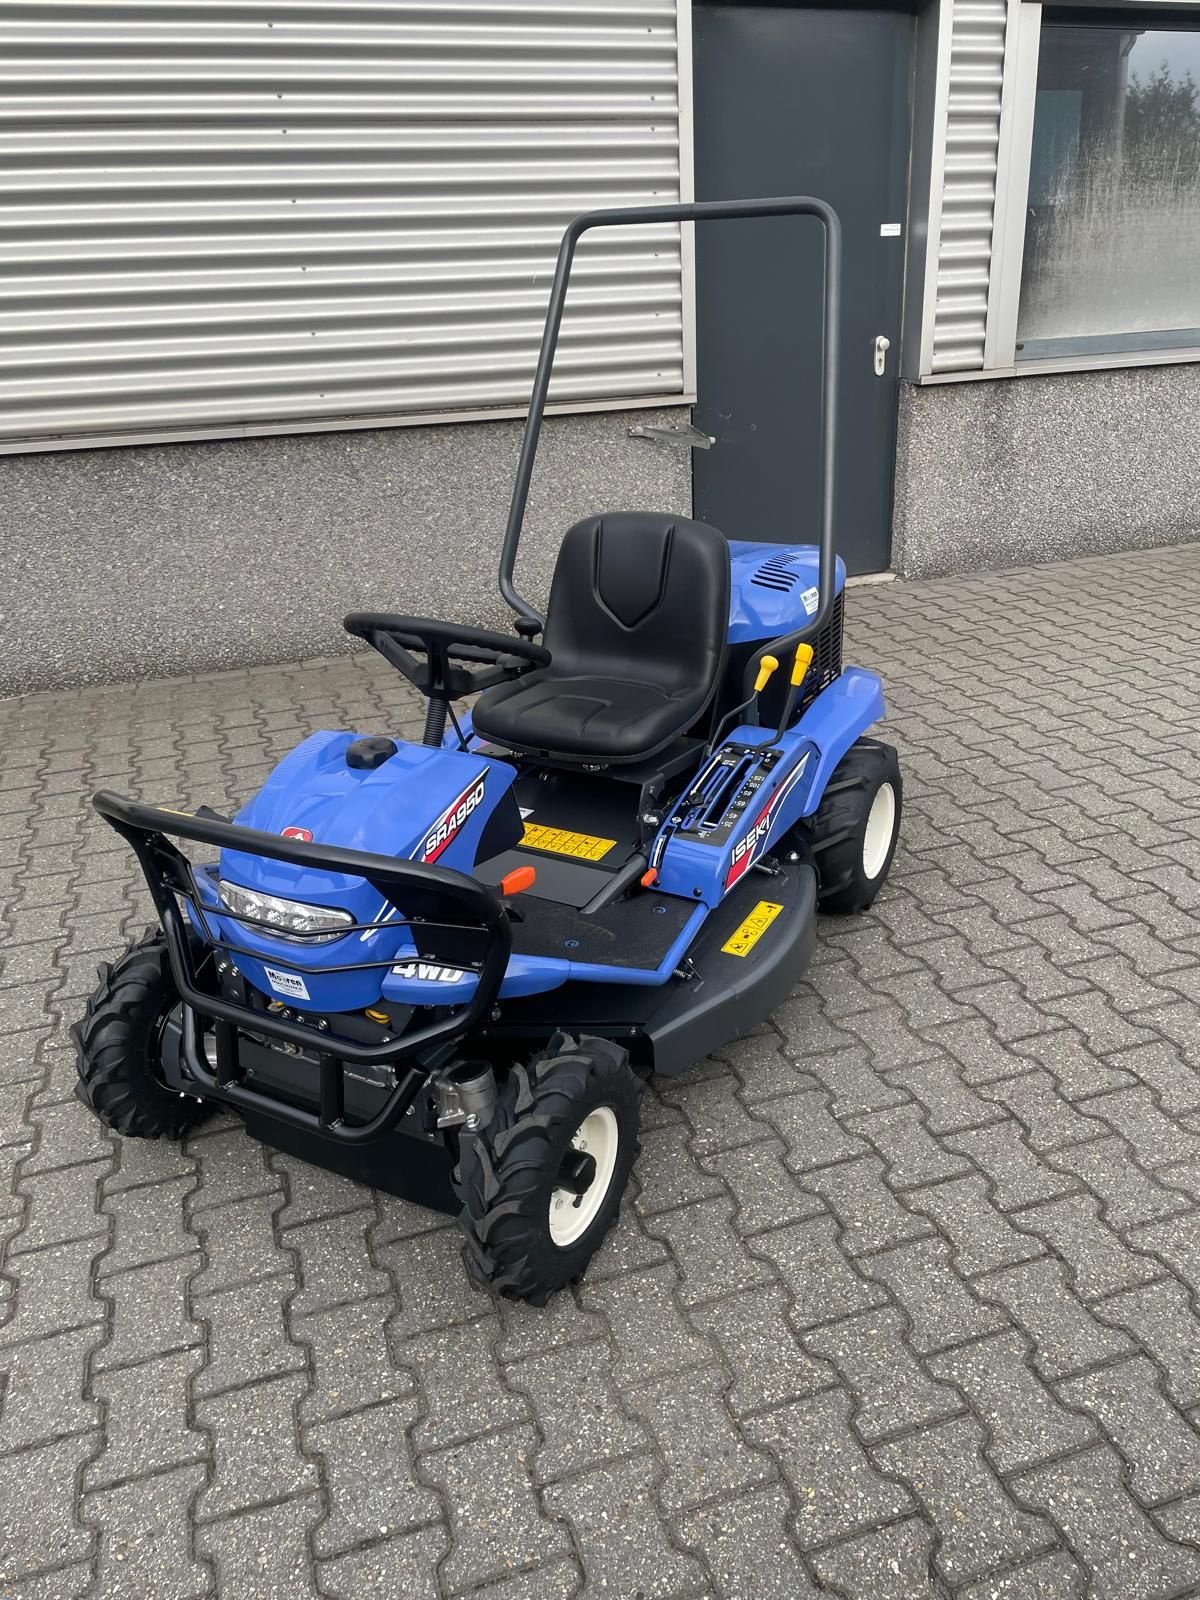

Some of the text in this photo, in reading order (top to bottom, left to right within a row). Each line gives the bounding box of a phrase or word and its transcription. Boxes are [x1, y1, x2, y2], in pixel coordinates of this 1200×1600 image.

[425, 781, 485, 857] SRA950
[731, 813, 770, 866] ISEKI
[392, 963, 464, 982] 4WD
